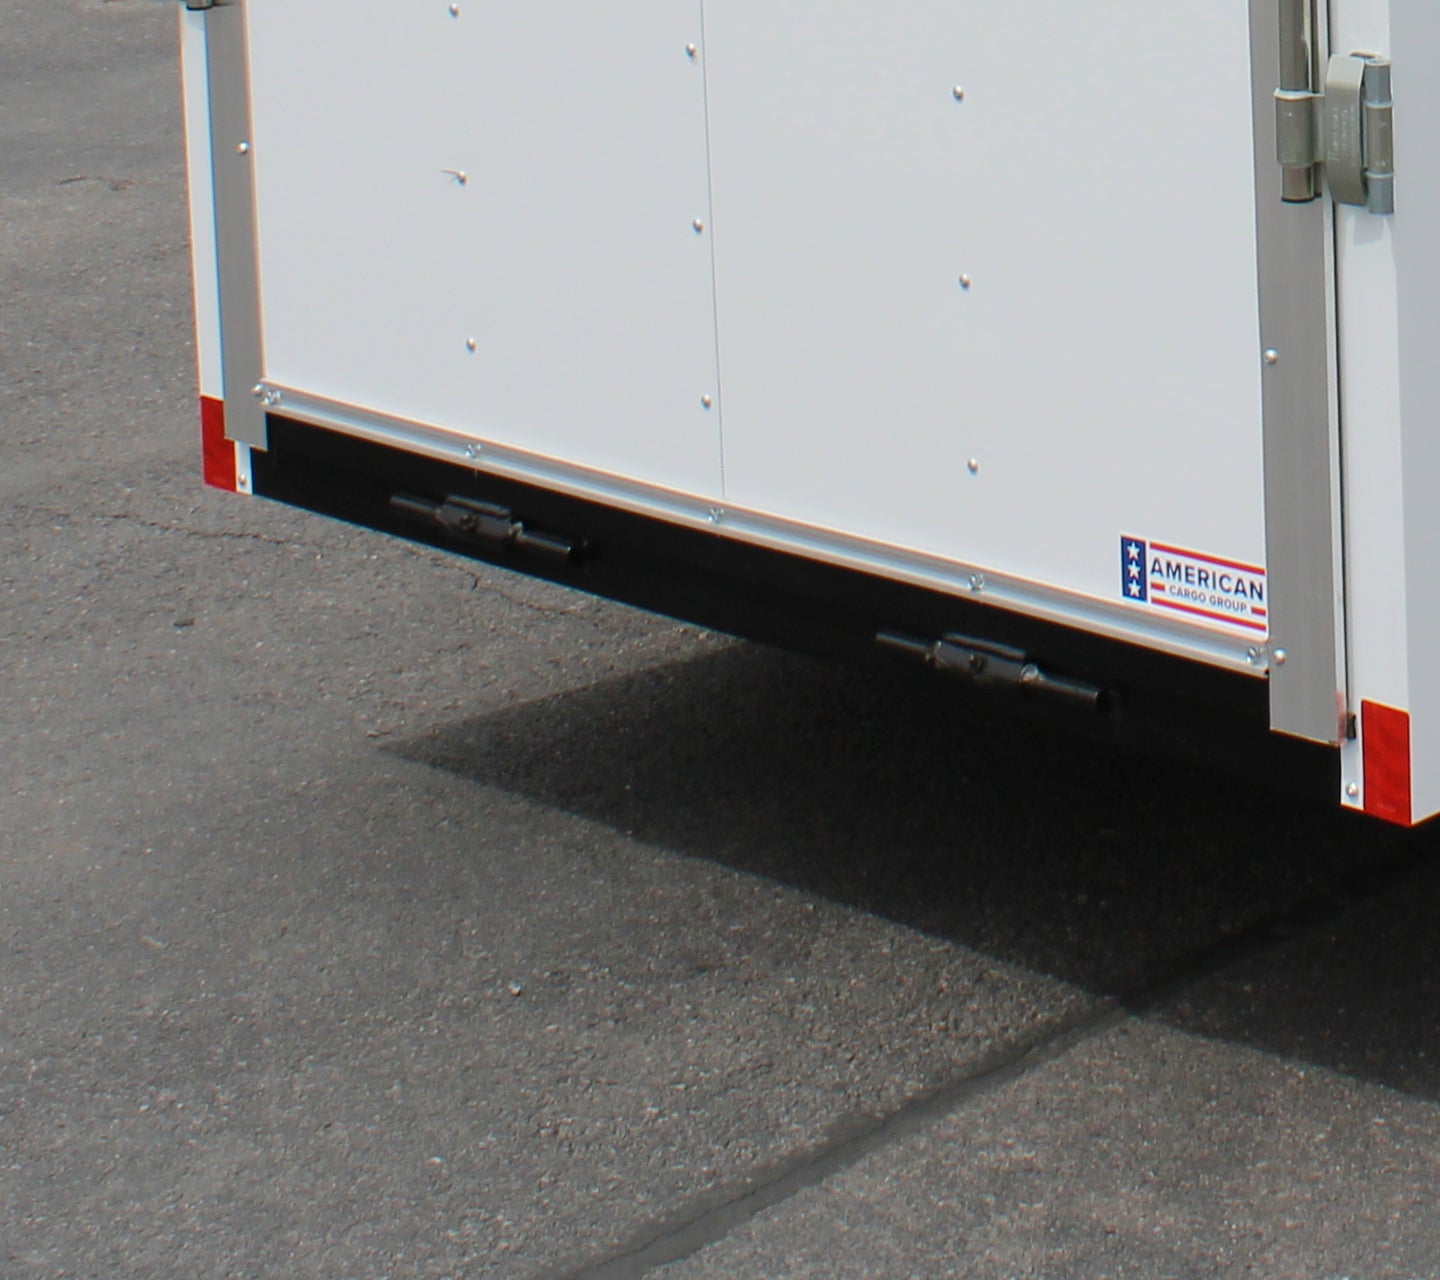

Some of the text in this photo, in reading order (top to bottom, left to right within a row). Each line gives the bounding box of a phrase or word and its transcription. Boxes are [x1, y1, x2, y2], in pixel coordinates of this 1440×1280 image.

[1150, 557, 1264, 601] AMERICAN
[1168, 584, 1248, 614] CARGO GROUP
